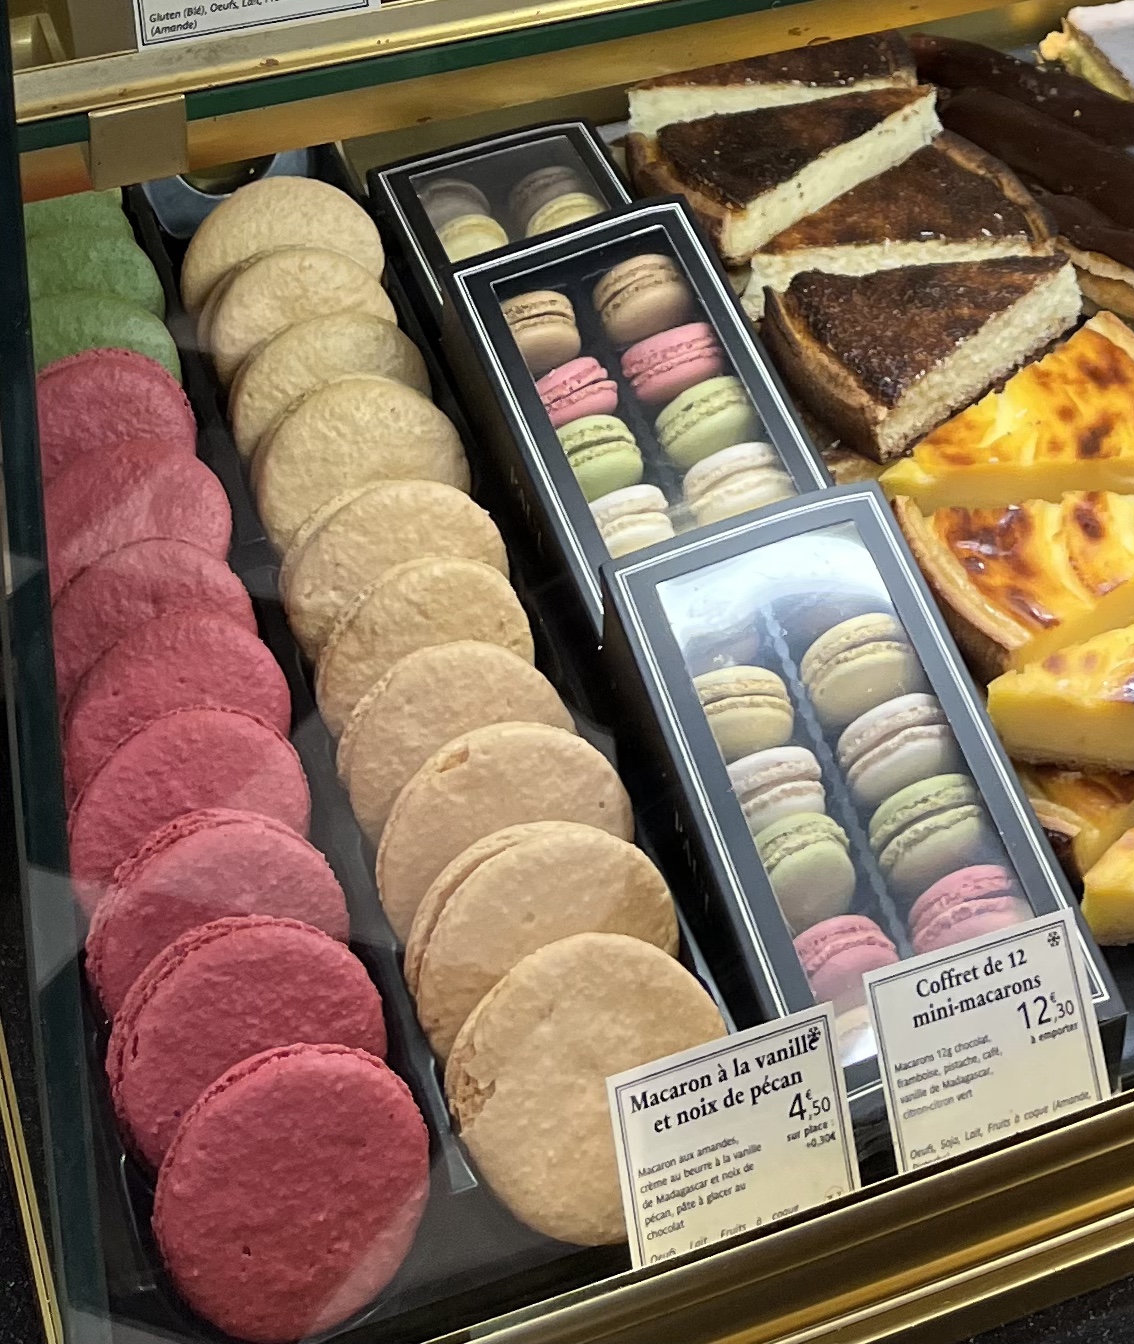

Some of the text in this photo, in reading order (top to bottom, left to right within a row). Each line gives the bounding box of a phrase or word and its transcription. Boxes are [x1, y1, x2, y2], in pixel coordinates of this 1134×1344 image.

[149, 9, 181, 24] Gluten
[150, 18, 197, 37] (Amande)
[916, 948, 1028, 998] Coffret de 12
[913, 974, 1042, 1029] mini-macarons
[629, 1034, 821, 1114] Macaron à la vanille
[653, 1070, 804, 1134] et noix de pécan
[638, 1155, 677, 1178] Macaron
[678, 1151, 695, 1164] aux
[640, 1177, 668, 1194] crème
[670, 1172, 682, 1183] au
[683, 1160, 713, 1178] beurre
[715, 1156, 721, 1167] à
[723, 1153, 731, 1165] la
[646, 1219, 685, 1241] chocolat
